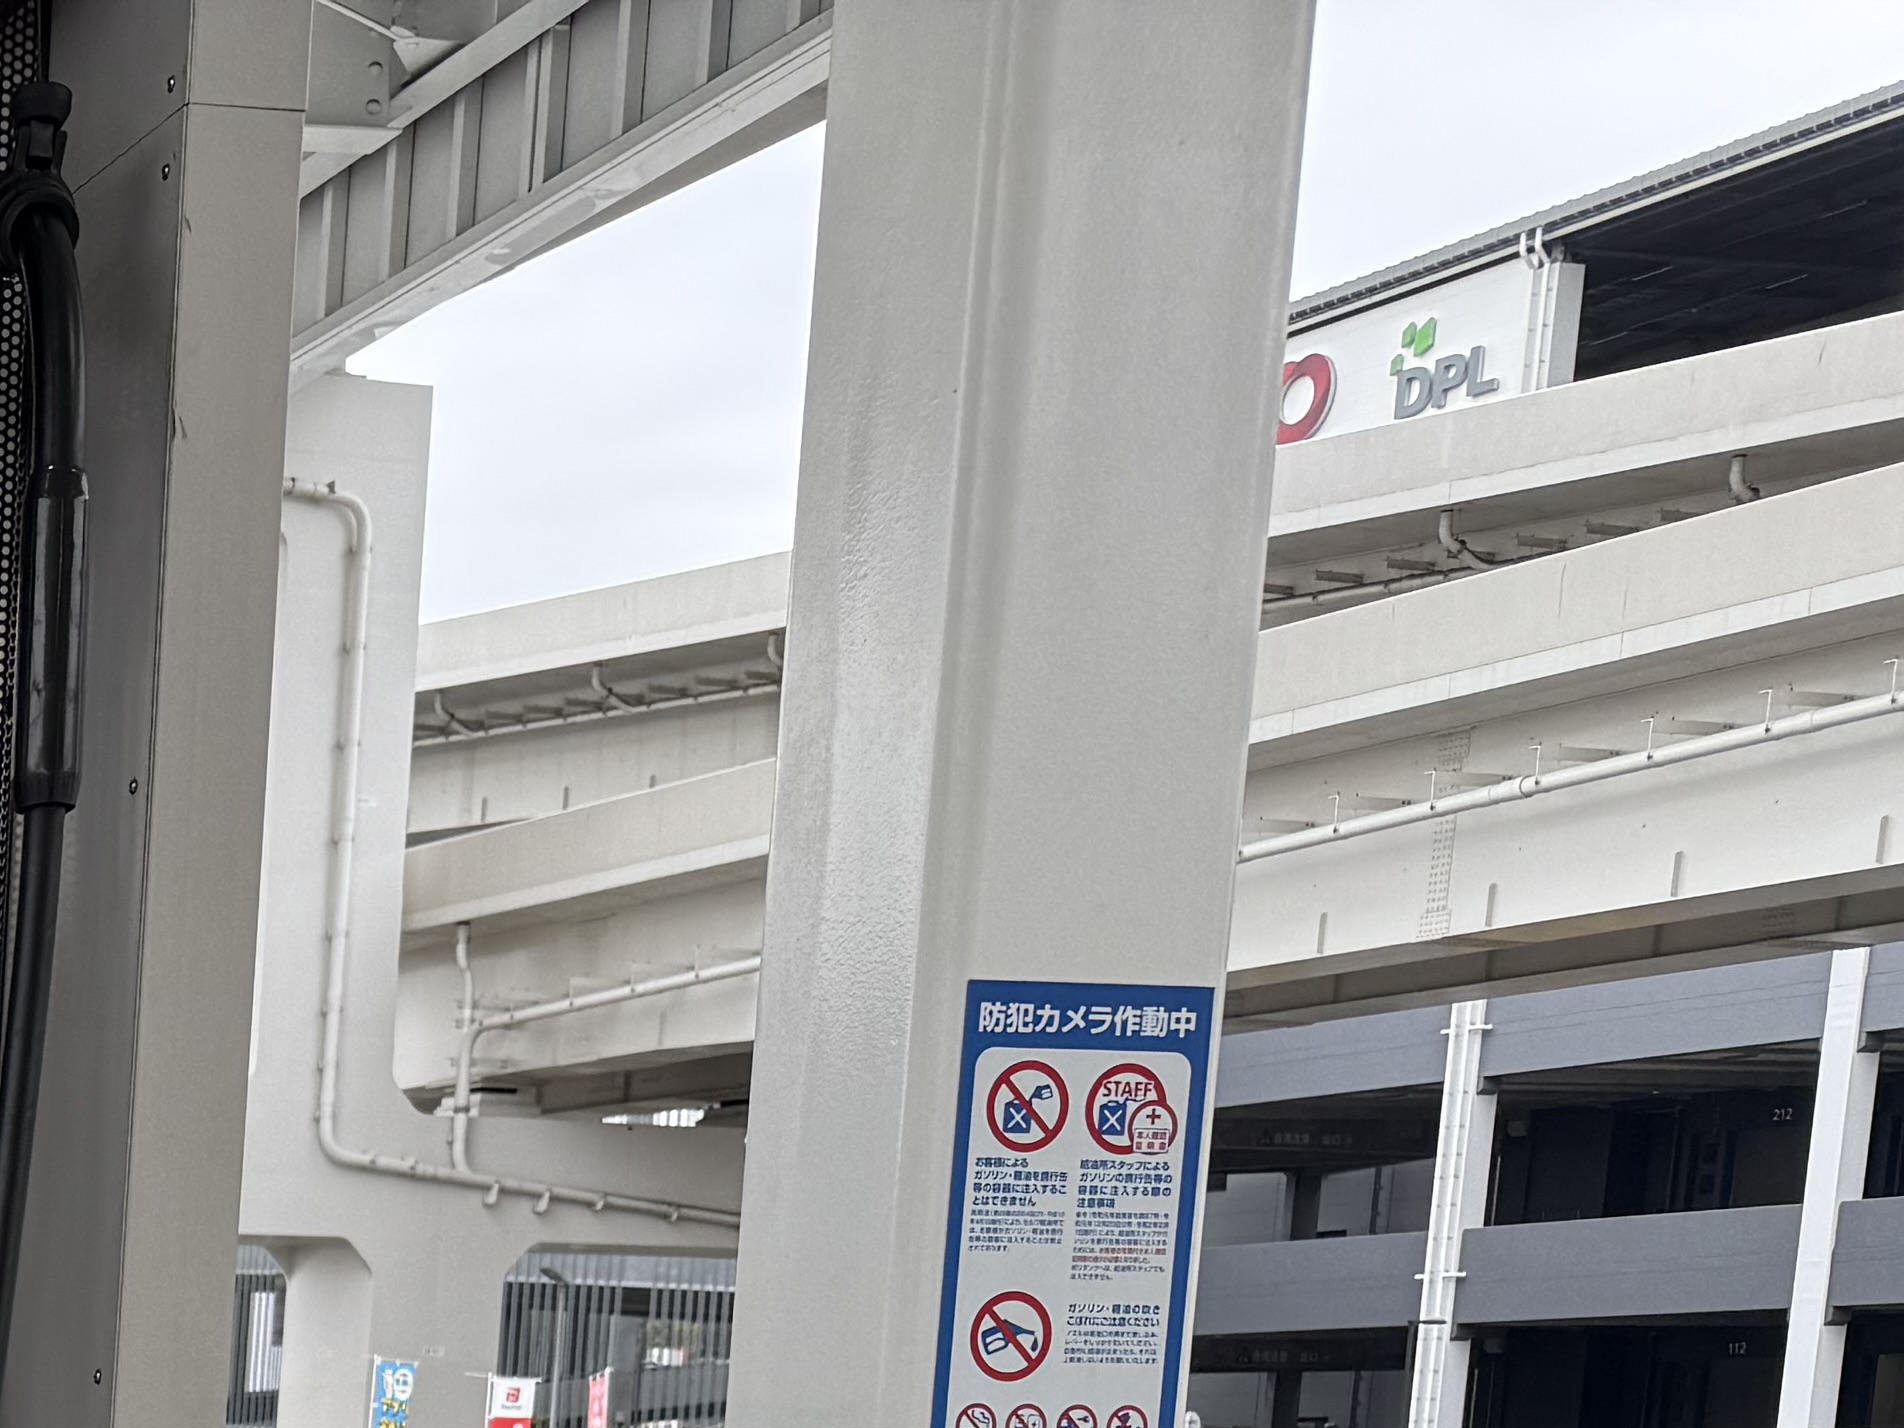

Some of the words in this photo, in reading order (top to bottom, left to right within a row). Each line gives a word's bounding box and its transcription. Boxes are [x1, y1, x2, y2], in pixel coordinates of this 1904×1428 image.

[1394, 345, 1500, 420] DPL
[979, 1001, 1197, 1039] 防犯カメラ作動中
[1102, 1081, 1153, 1098] STAFF
[1773, 1108, 1792, 1120] 212
[1080, 1159, 1170, 1170] 給油所スタッフによる
[972, 1195, 1037, 1207] とはできません
